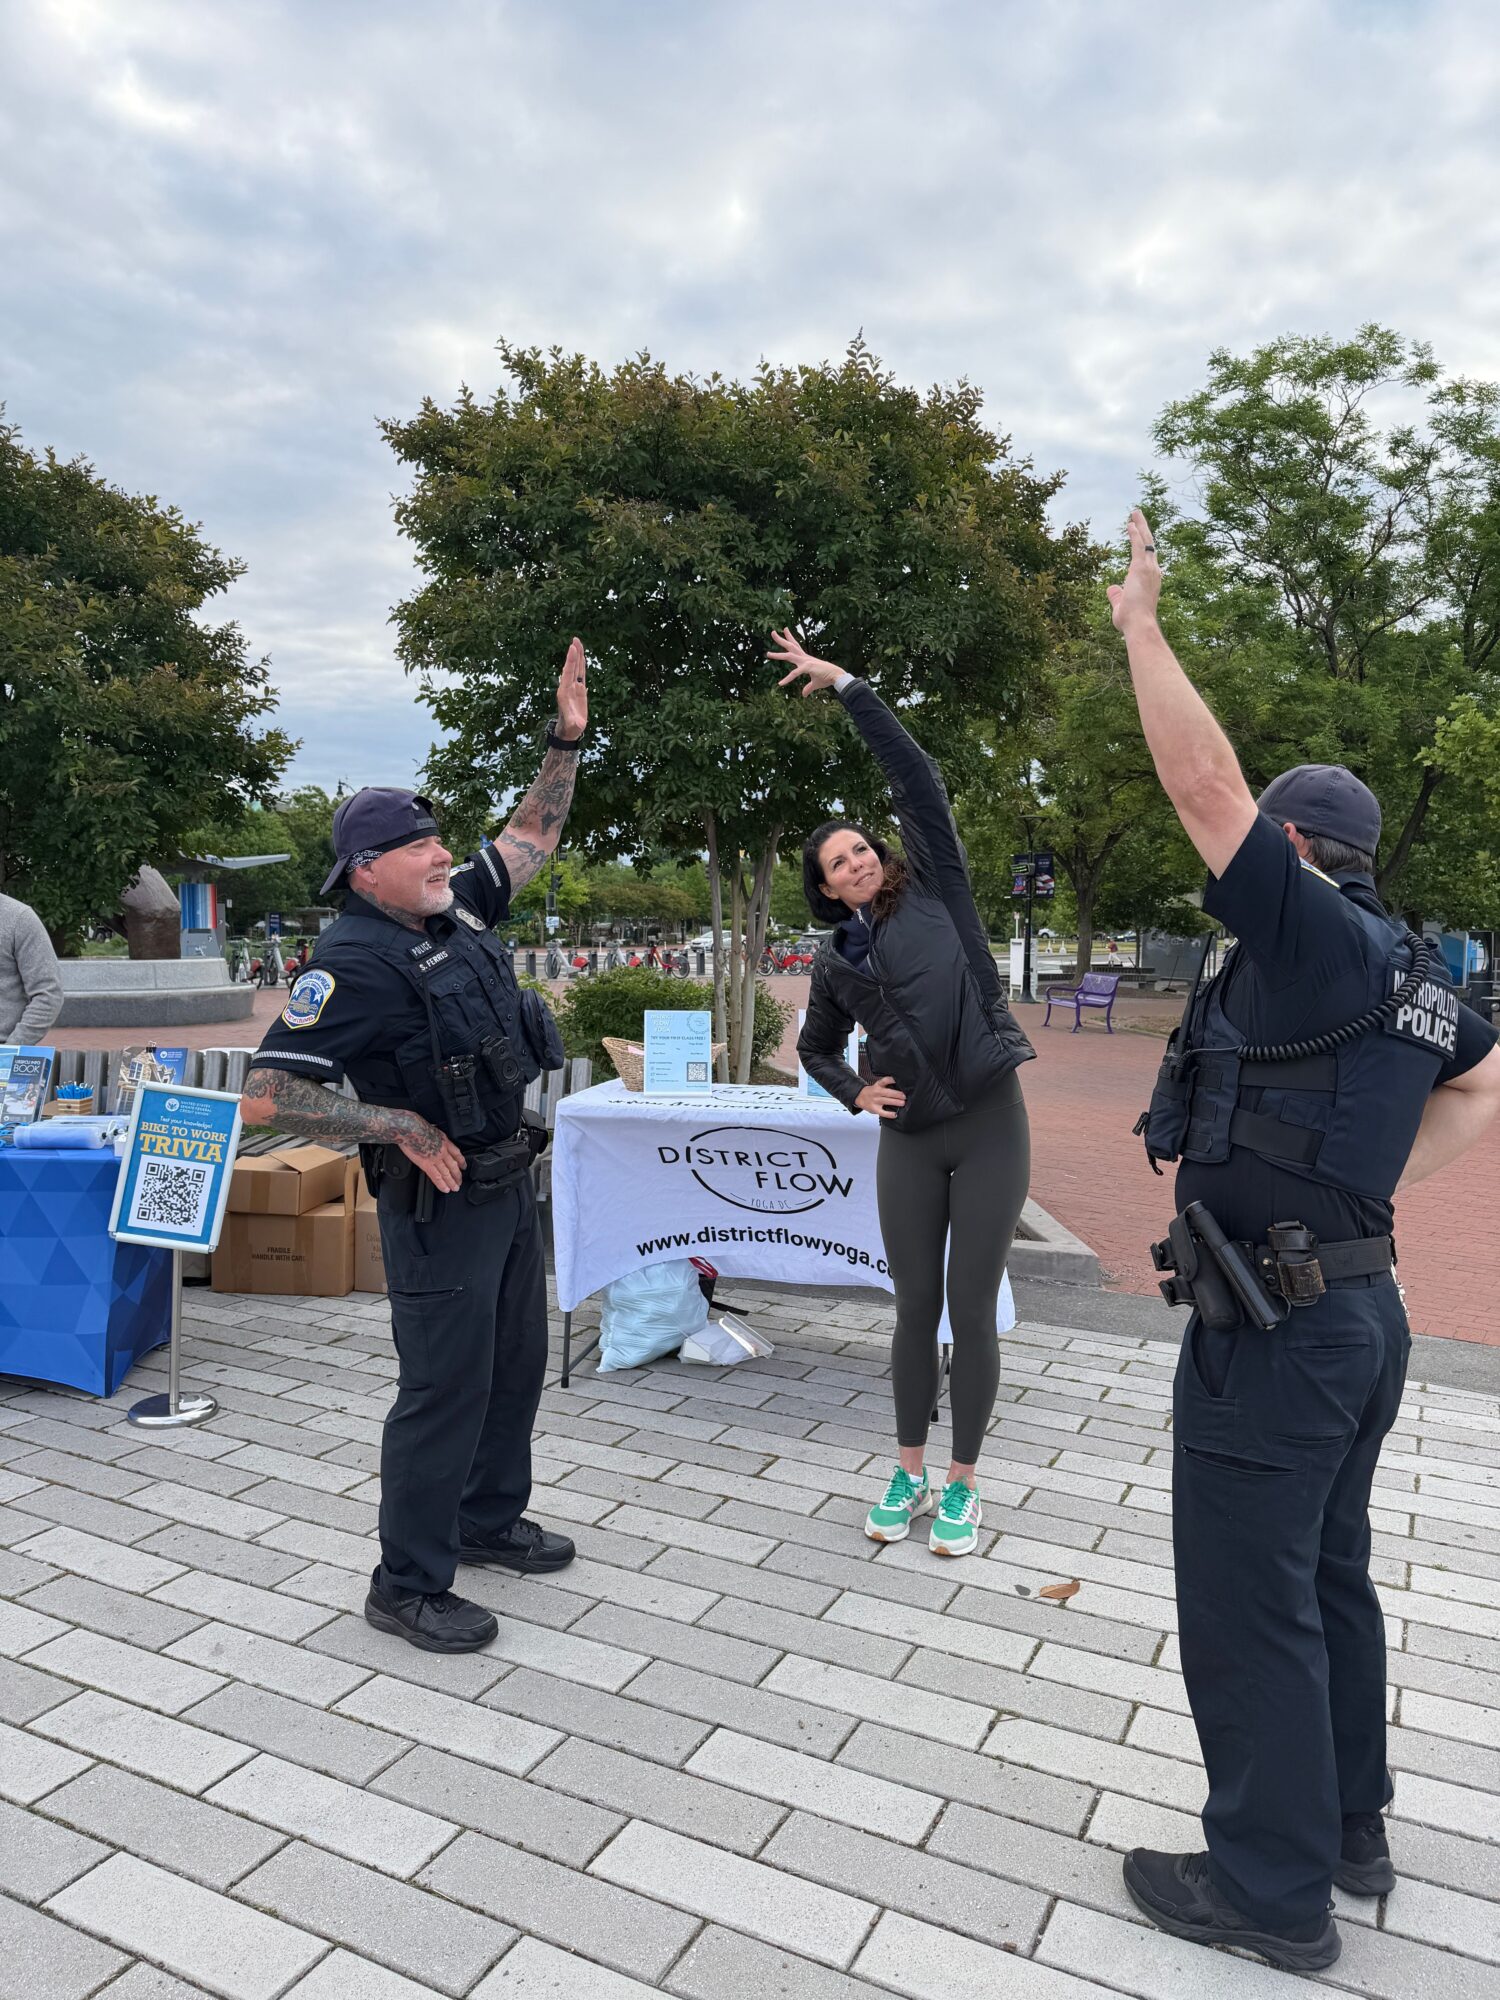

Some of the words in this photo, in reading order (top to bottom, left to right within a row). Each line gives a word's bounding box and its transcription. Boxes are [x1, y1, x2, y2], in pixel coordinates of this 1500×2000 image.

[411, 941, 432, 956] POLICE
[426, 950, 449, 967] FERRIS
[1396, 1004, 1456, 1052] POLICE
[13, 1063, 40, 1074] BOOK
[140, 1121, 169, 1134] BIKE
[171, 1126, 188, 1137] TO
[191, 1128, 228, 1143] WORK
[183, 1119, 213, 1129] knowledge!
[139, 1132, 222, 1163] TRIVIA
[657, 1145, 809, 1168] DISTRICT
[755, 1171, 854, 1198] FLOW
[751, 1198, 774, 1209] YOGA
[777, 1199, 791, 1209] DC
